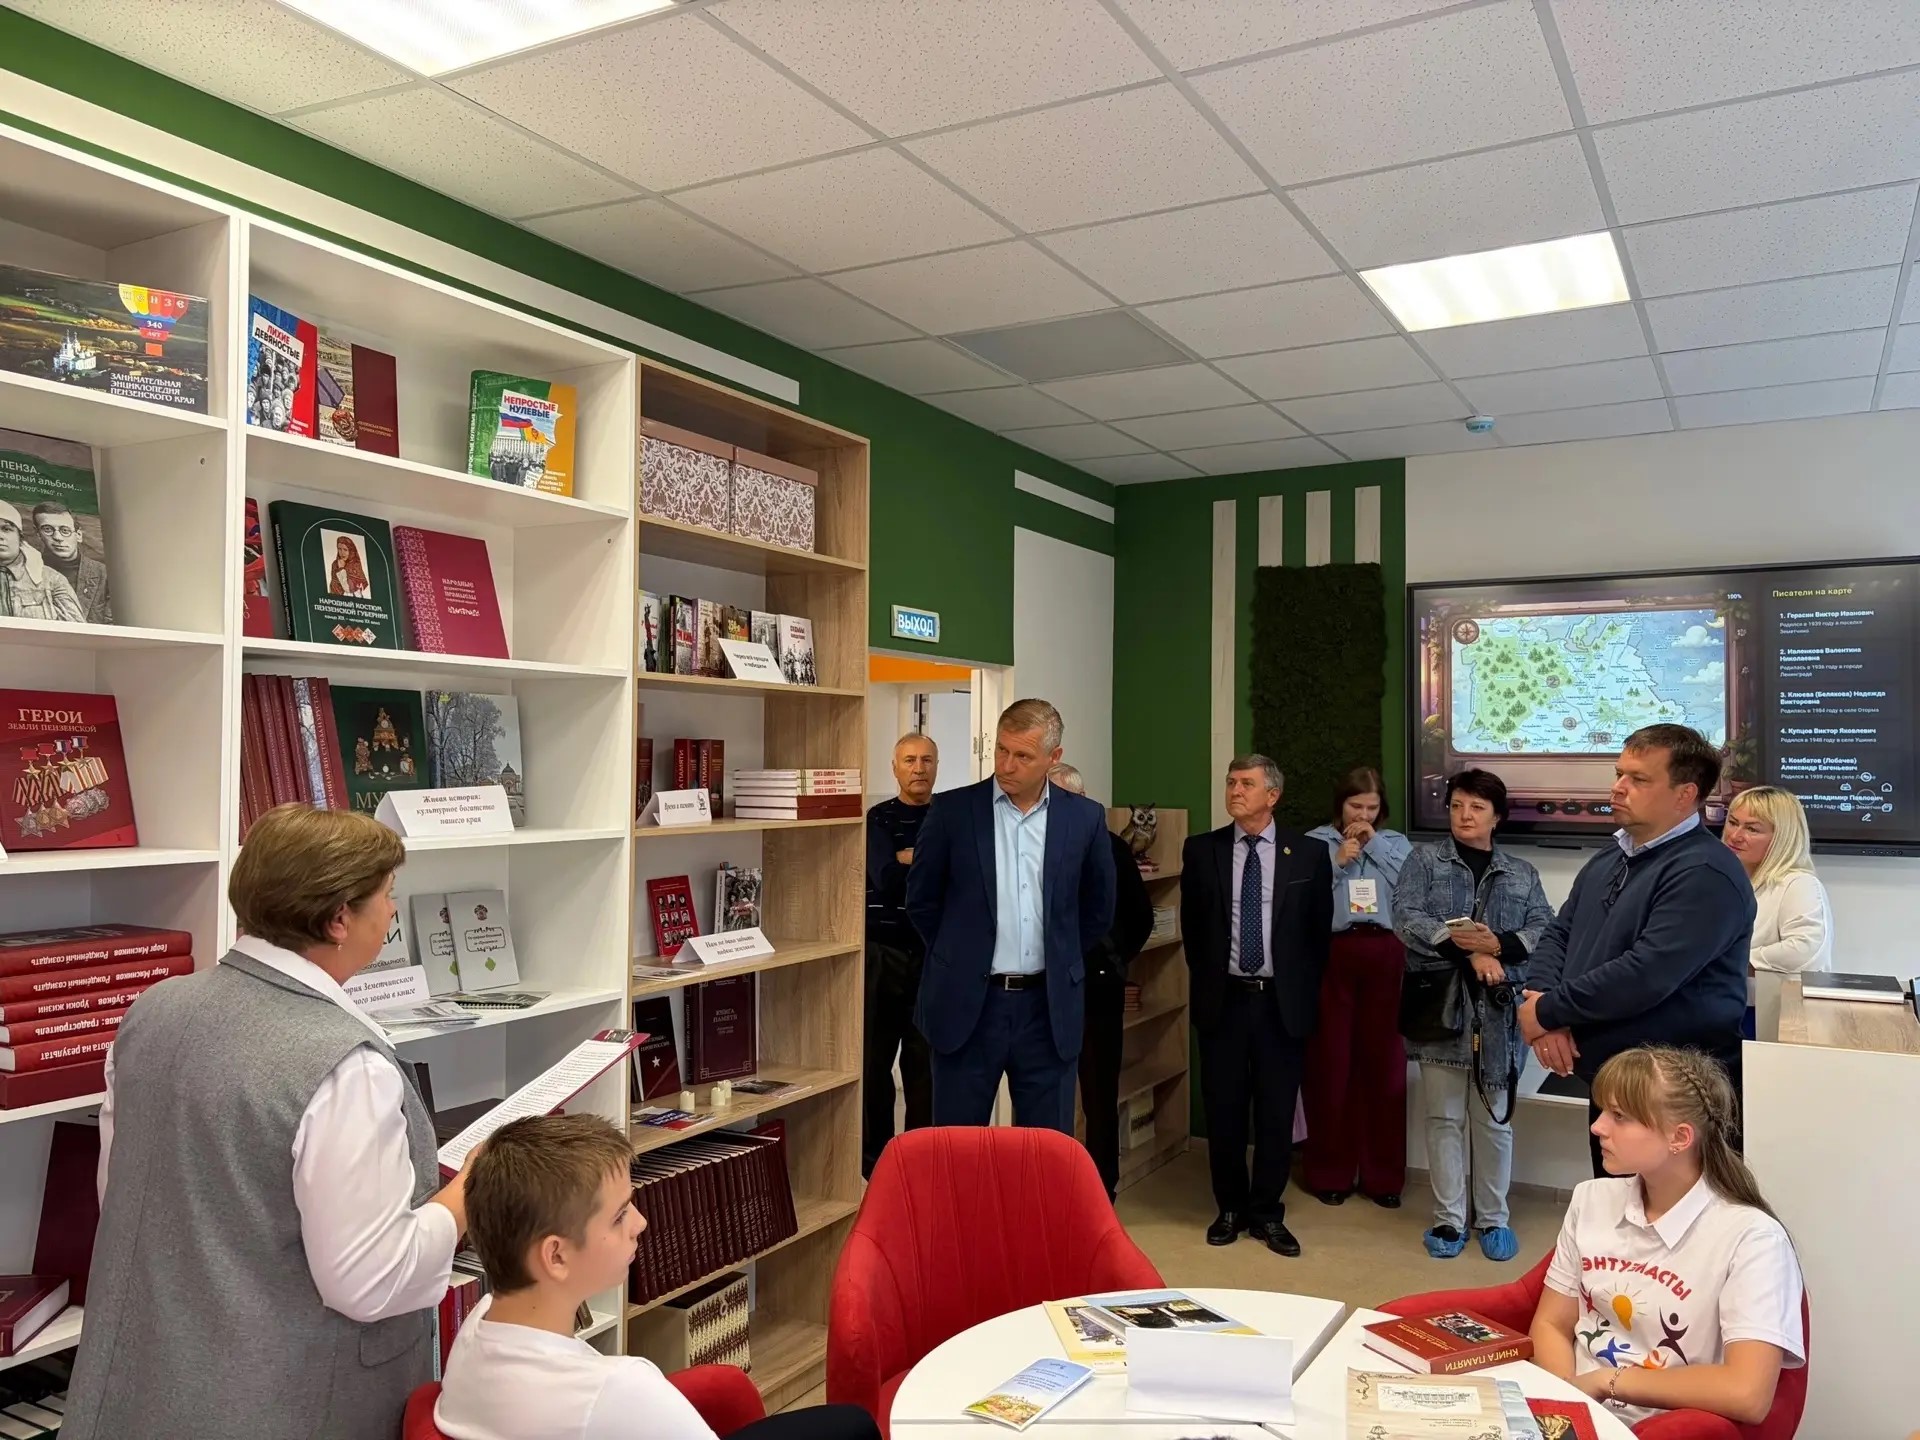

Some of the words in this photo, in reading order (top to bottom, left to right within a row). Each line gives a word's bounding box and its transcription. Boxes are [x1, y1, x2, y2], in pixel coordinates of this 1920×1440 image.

[147, 320, 163, 329] 340
[267, 324, 291, 345] ЛИХИЕ
[254, 327, 300, 361] ДЕВЯНОСТЫЕ
[110, 372, 182, 388] ЗАНИМАТЕЛЬНАЯ
[110, 380, 180, 396] ЭНЦИКЛОПЕДИЯ
[110, 387, 173, 402] ПЕНЗЕНСКОГО
[174, 396, 195, 405] КРАЯ
[503, 395, 557, 412] НЕПРОСТЫЕ
[509, 404, 550, 419] НУЛЕВЫЕ
[467, 442, 475, 476] ЕПРОСТЫЕ
[1, 459, 40, 475] ПЕНЗА.
[1772, 588, 1813, 598] Писатели
[1827, 587, 1853, 597] карте
[313, 604, 357, 616] ПЕНЗЕНСКОЙ
[356, 610, 389, 620] ГУБЕРНИИ
[318, 597, 355, 608] НАРОДНЫЙ
[355, 602, 383, 612] КОСТЮМ
[897, 612, 934, 637] ВЫХОД
[17, 708, 84, 725] ГЕРОИ
[7, 722, 39, 731] ЗЕМЛИ
[40, 724, 98, 733] ПЕНЗЕНСКОЙ
[1813, 727, 1838, 735] Виктор
[422, 794, 448, 803] Живая
[448, 794, 481, 803] история:
[416, 807, 459, 817] культурное
[459, 804, 496, 813] богатство
[465, 816, 482, 826] края
[113, 945, 149, 957] Мясников
[149, 943, 168, 953] Георг
[30, 955, 65, 966] созидать
[115, 969, 151, 981] Мясников
[150, 966, 169, 976] Георг
[32, 980, 67, 992] созидать
[343, 985, 362, 996] ория
[363, 975, 414, 991] Земетчинского
[97, 993, 126, 1007] Зубков
[126, 992, 141, 1002] рис
[370, 990, 391, 1002] завода
[396, 988, 416, 997] книге
[37, 1002, 65, 1014] жизни
[66, 997, 90, 1012] Уроки
[35, 1016, 100, 1036] градостроитель
[40, 1044, 81, 1061] результат
[81, 1044, 92, 1053] на
[92, 1039, 115, 1053] абота
[1581, 1255, 1693, 1301] ЭНТУЗИАСТЫ
[1487, 1347, 1520, 1364] КНИГА
[1444, 1356, 1486, 1373] ПАМЯТИ
